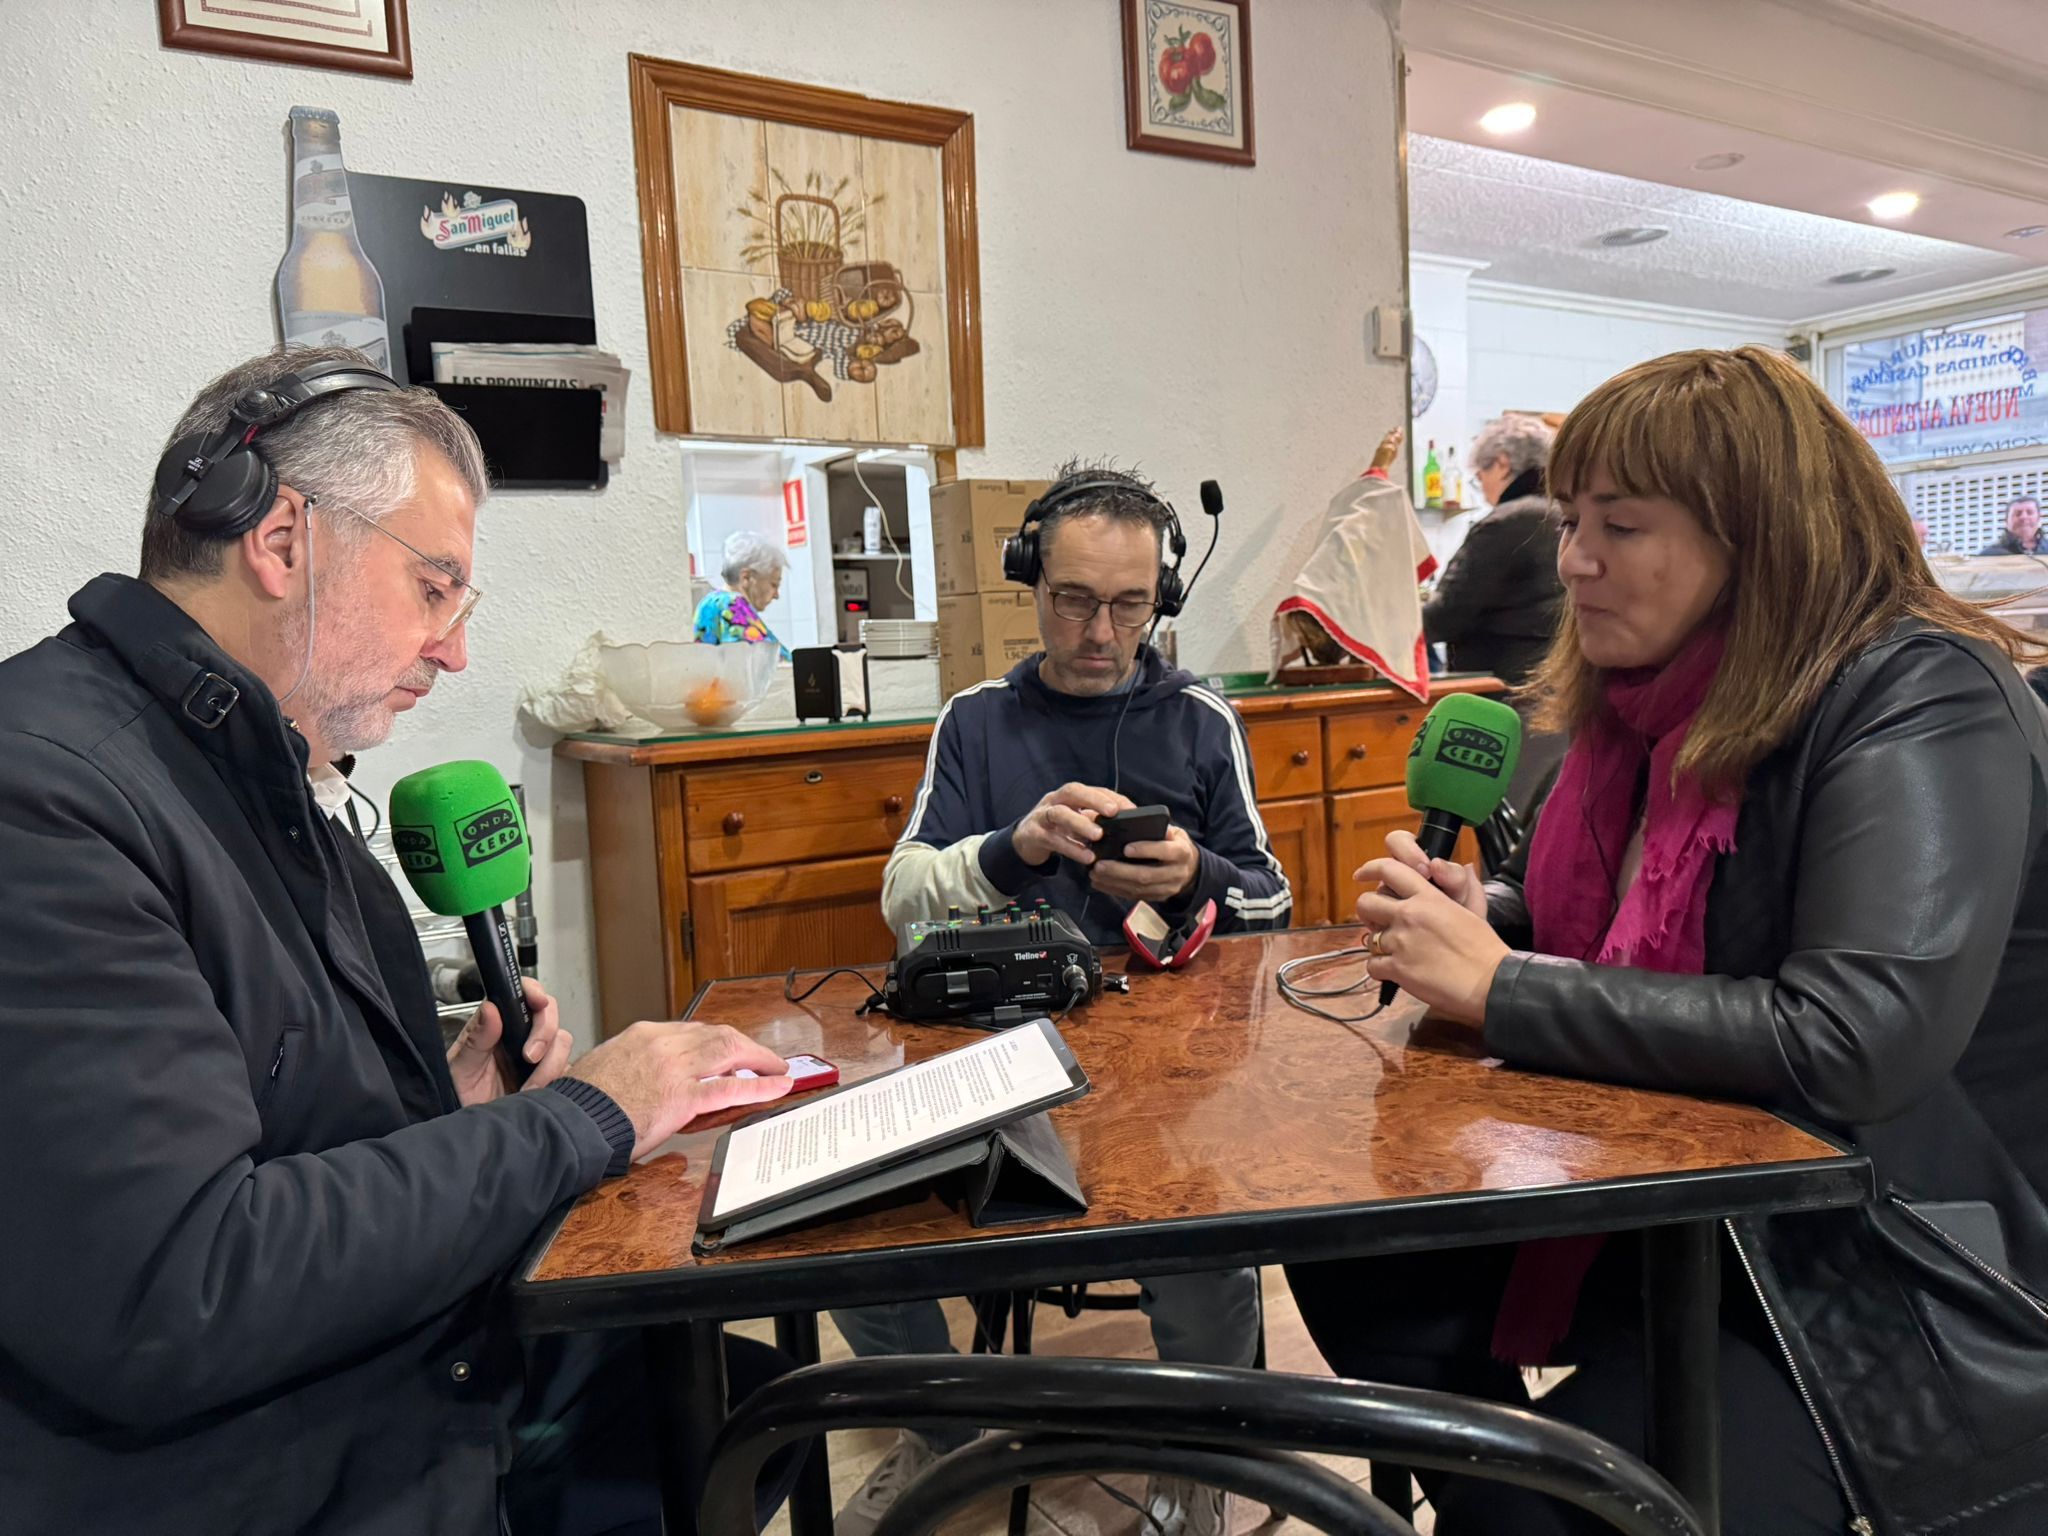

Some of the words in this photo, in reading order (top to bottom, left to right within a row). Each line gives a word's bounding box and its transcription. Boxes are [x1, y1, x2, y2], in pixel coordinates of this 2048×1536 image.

[1453, 730, 1498, 750] ONDA
[1450, 746, 1494, 767] CERO
[467, 813, 510, 836] ONDA
[476, 829, 515, 854] CERO
[503, 937, 523, 998] SENNHEISER
